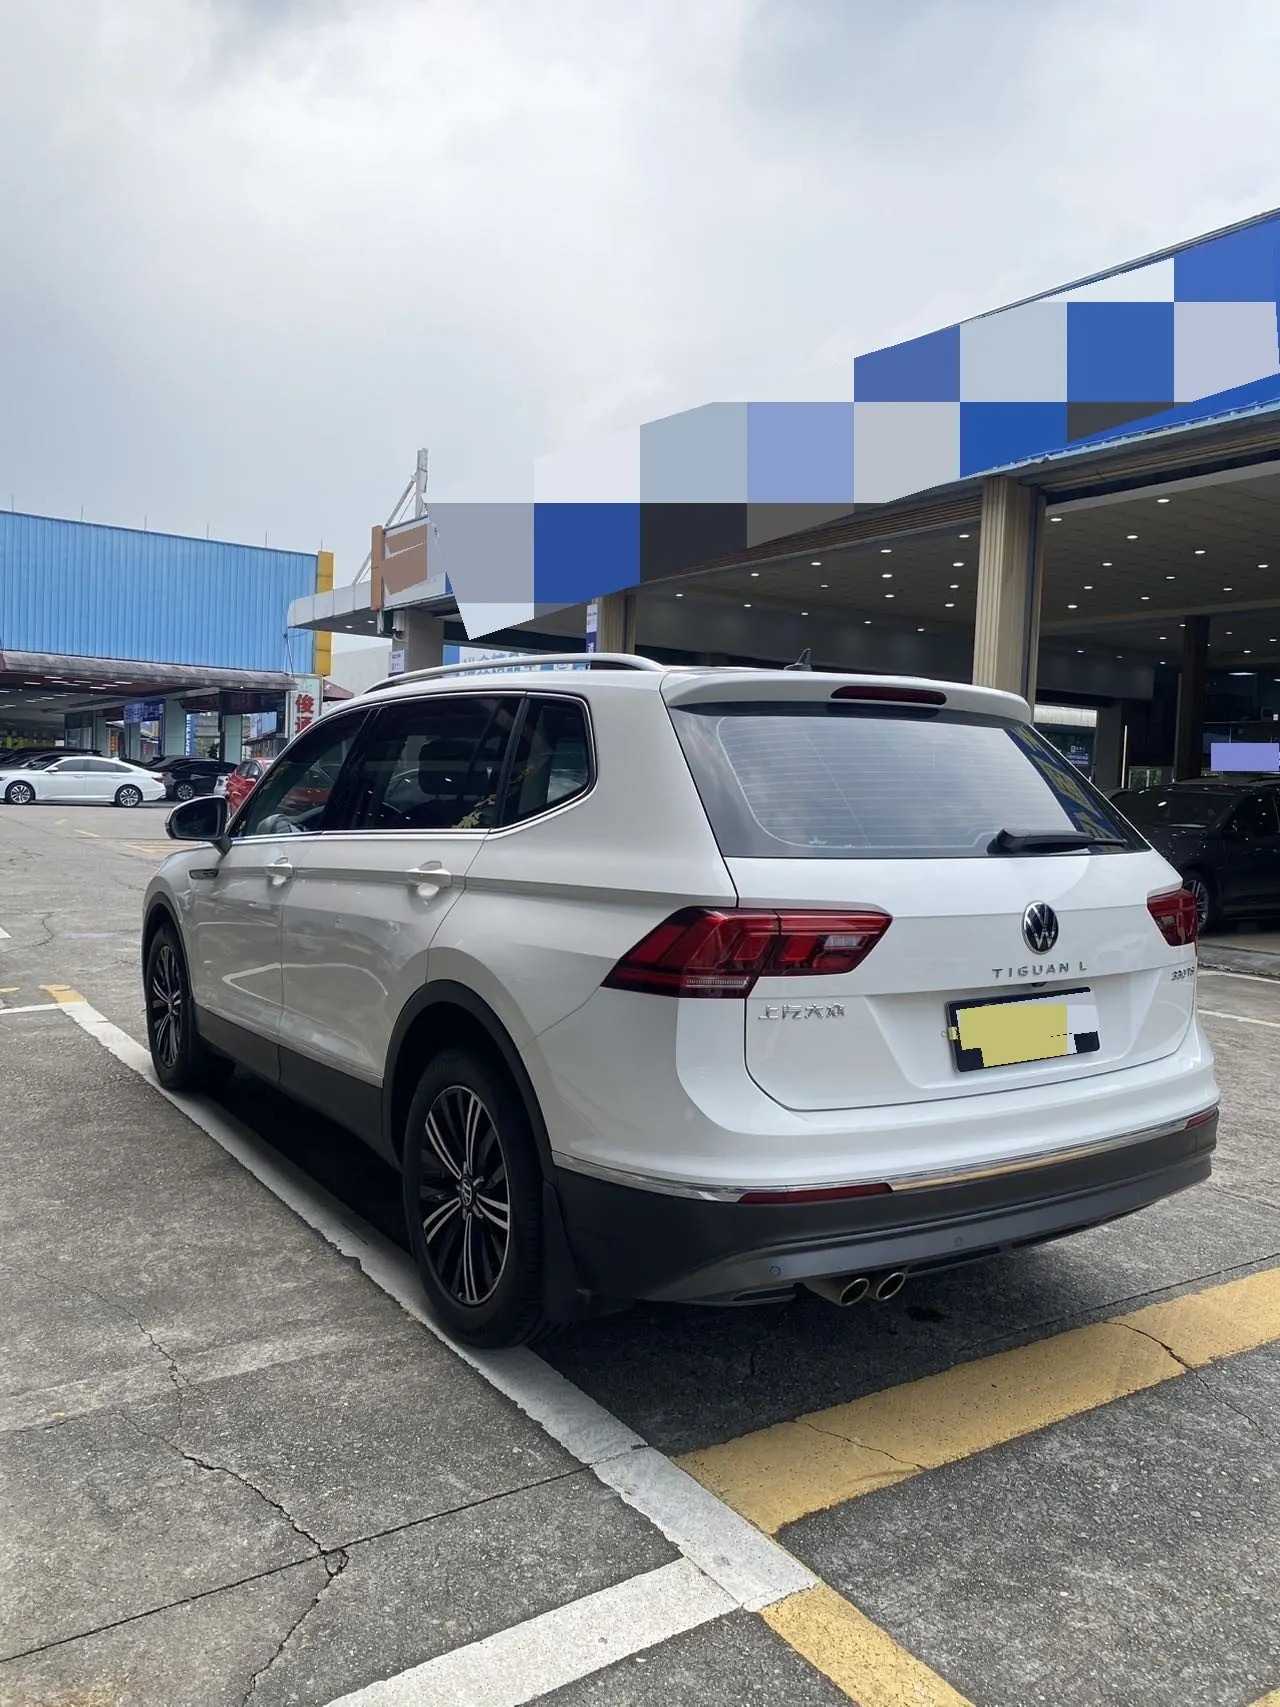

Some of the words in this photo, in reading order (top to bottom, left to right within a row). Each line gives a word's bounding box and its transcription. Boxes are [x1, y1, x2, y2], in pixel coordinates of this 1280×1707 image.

[991, 962, 1069, 979] TIGUAN
[1079, 961, 1088, 971] L
[758, 1003, 846, 1021] 上汽大众
